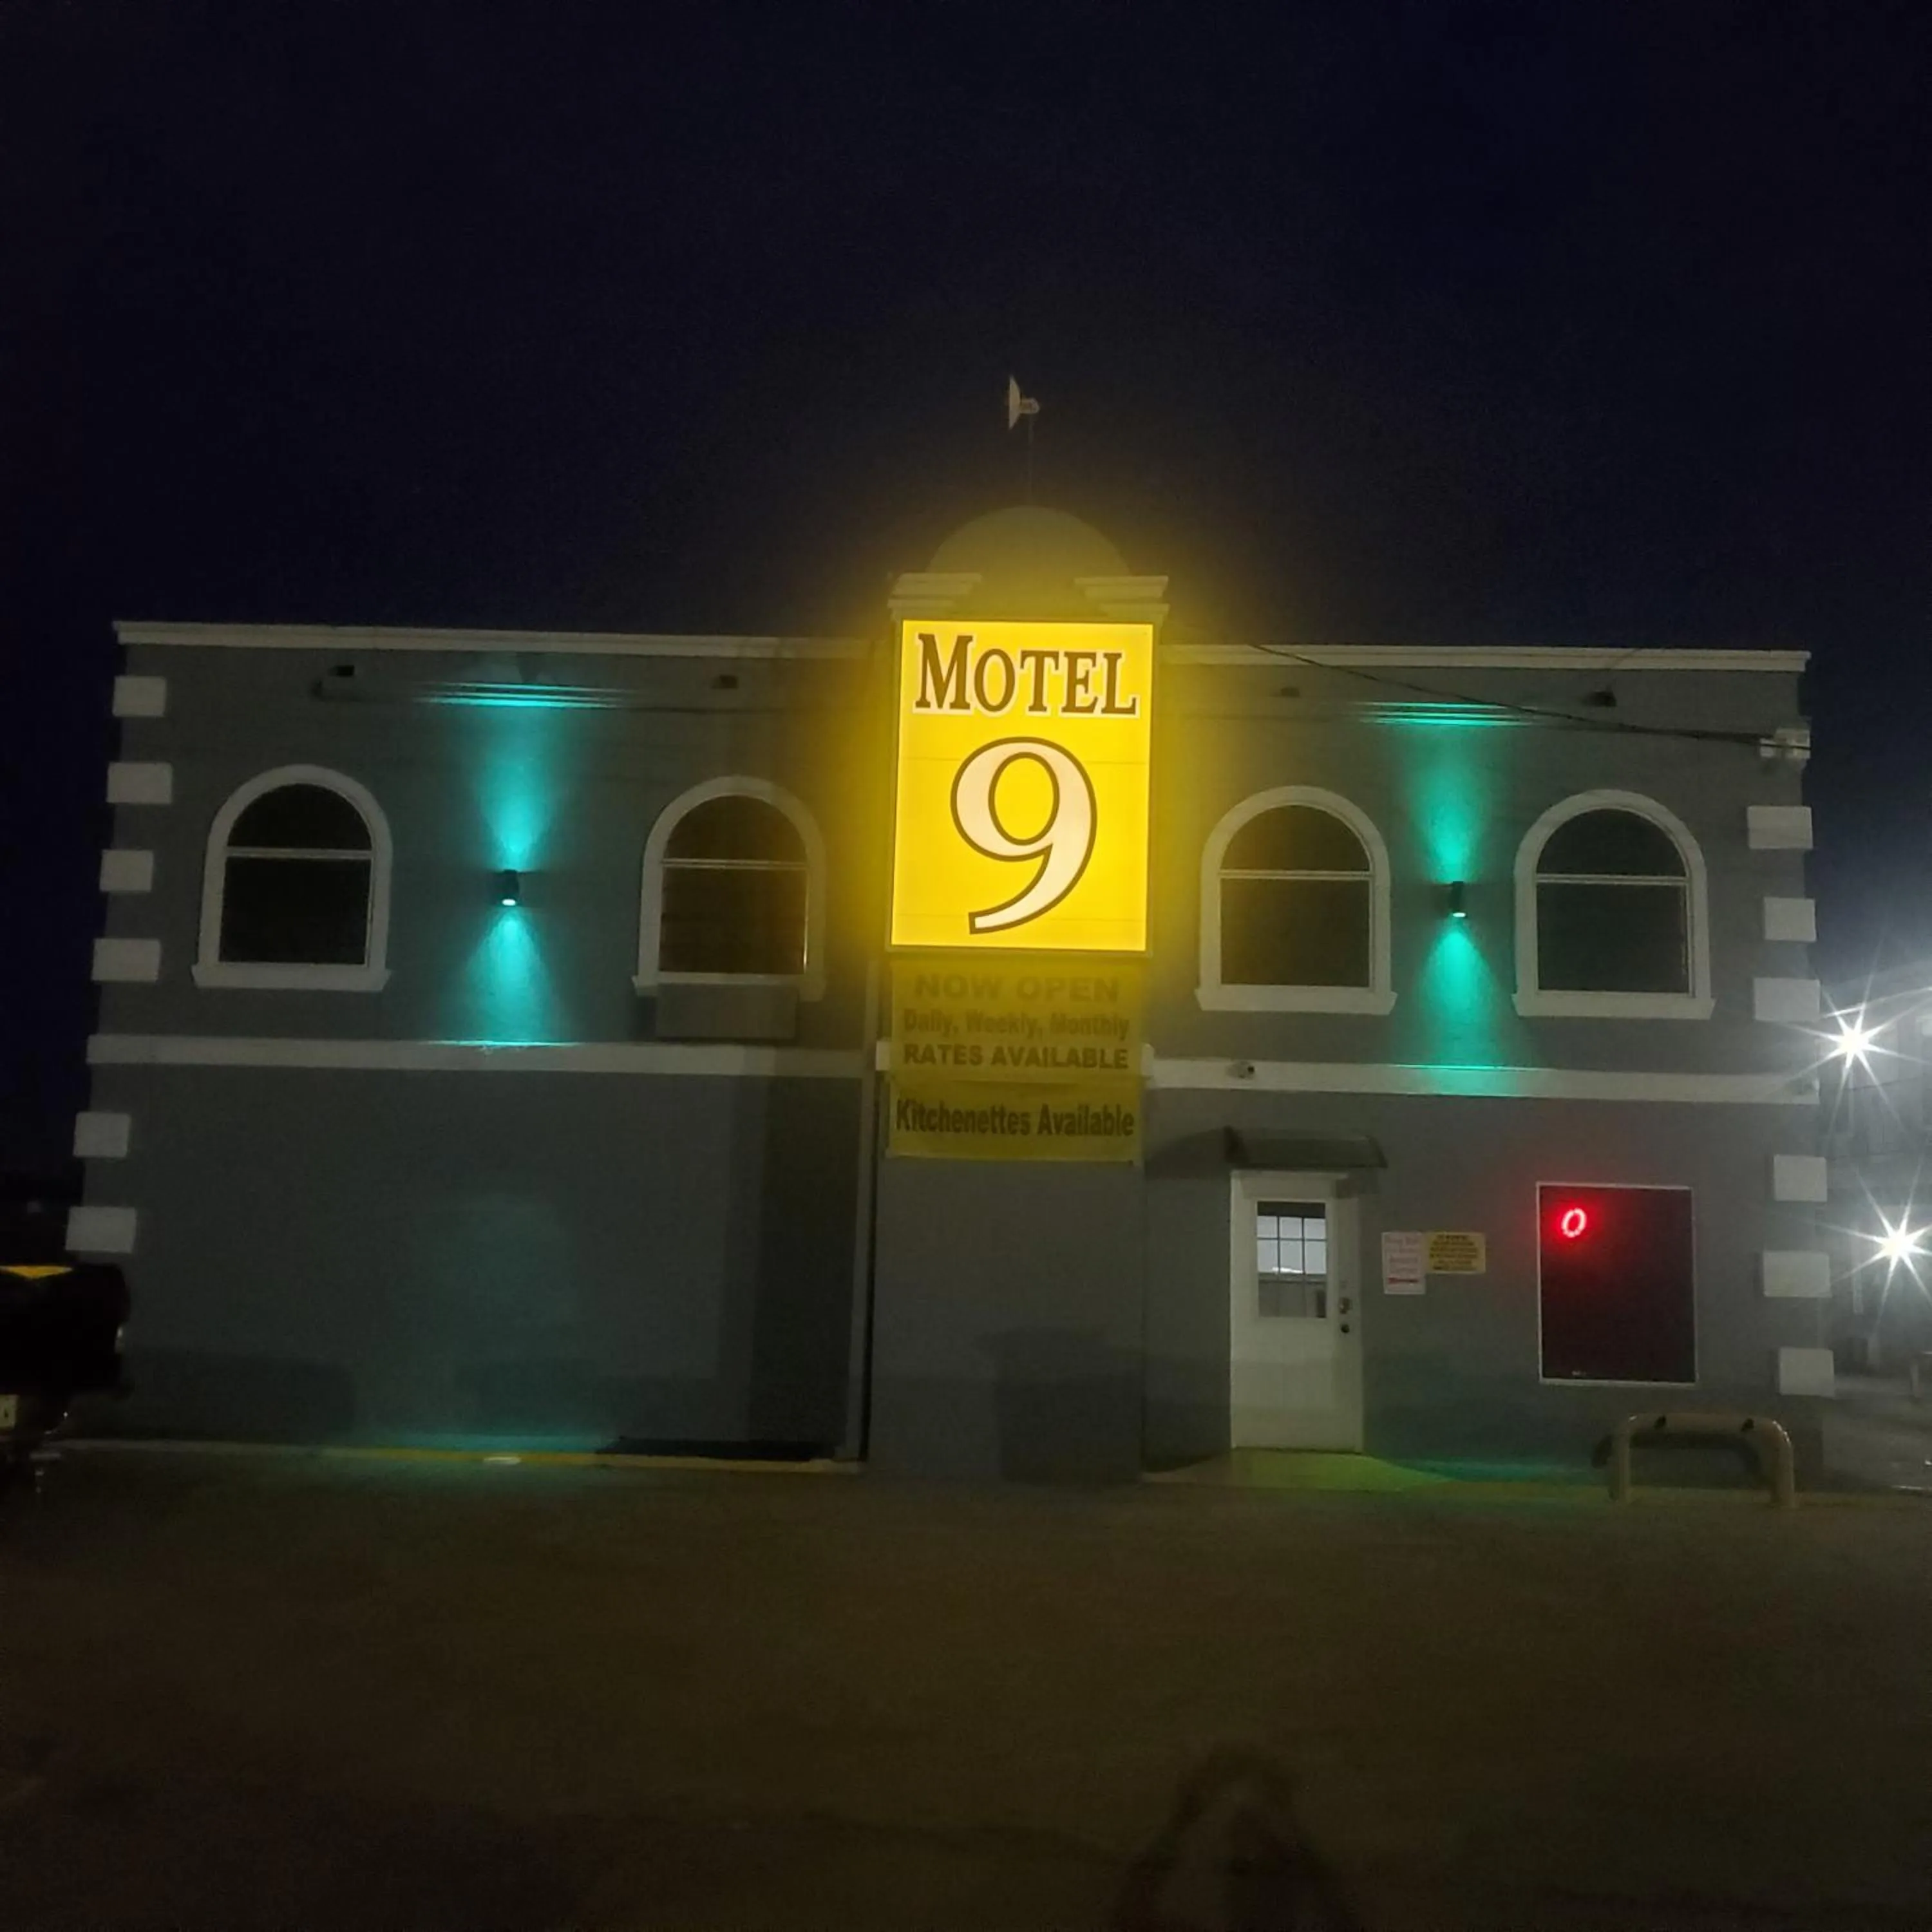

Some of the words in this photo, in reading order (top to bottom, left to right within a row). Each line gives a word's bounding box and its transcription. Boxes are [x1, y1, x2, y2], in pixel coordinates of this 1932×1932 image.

[914, 632, 1138, 715] MOTEL
[950, 736, 1097, 935] 9
[915, 974, 1001, 999] NOW
[1016, 976, 1120, 1003] OPEN
[904, 1008, 958, 1034] Daily,
[967, 1010, 1043, 1038] Weekly,
[1051, 1012, 1130, 1041] Monthly
[904, 1043, 983, 1065] RATES
[990, 1045, 1128, 1069] AVAILABLE
[896, 1099, 1030, 1136] Kitchenettes
[1037, 1103, 1135, 1137] Available
